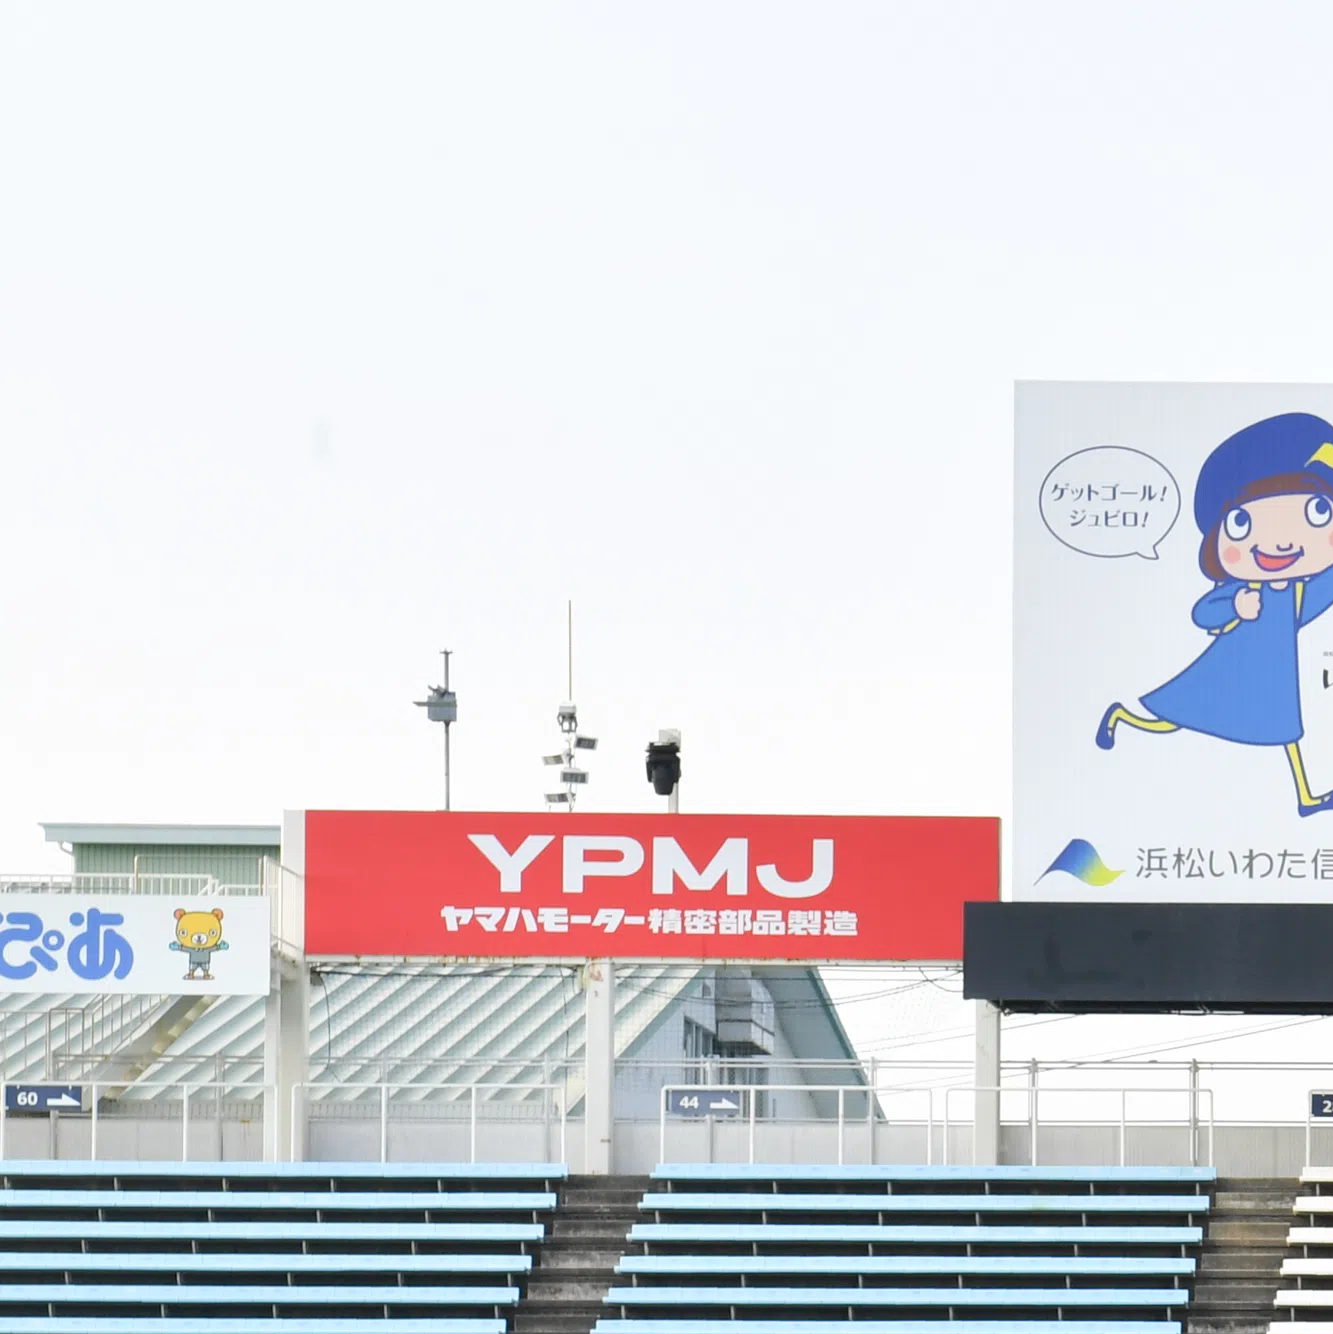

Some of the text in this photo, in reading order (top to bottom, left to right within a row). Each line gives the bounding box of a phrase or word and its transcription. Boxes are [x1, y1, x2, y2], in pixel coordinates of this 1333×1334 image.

[467, 834, 835, 899] YPMJ
[441, 904, 858, 938] ヤマハモーター精密部品製造
[17, 1091, 38, 1107] 60
[679, 1095, 699, 1110] 44
